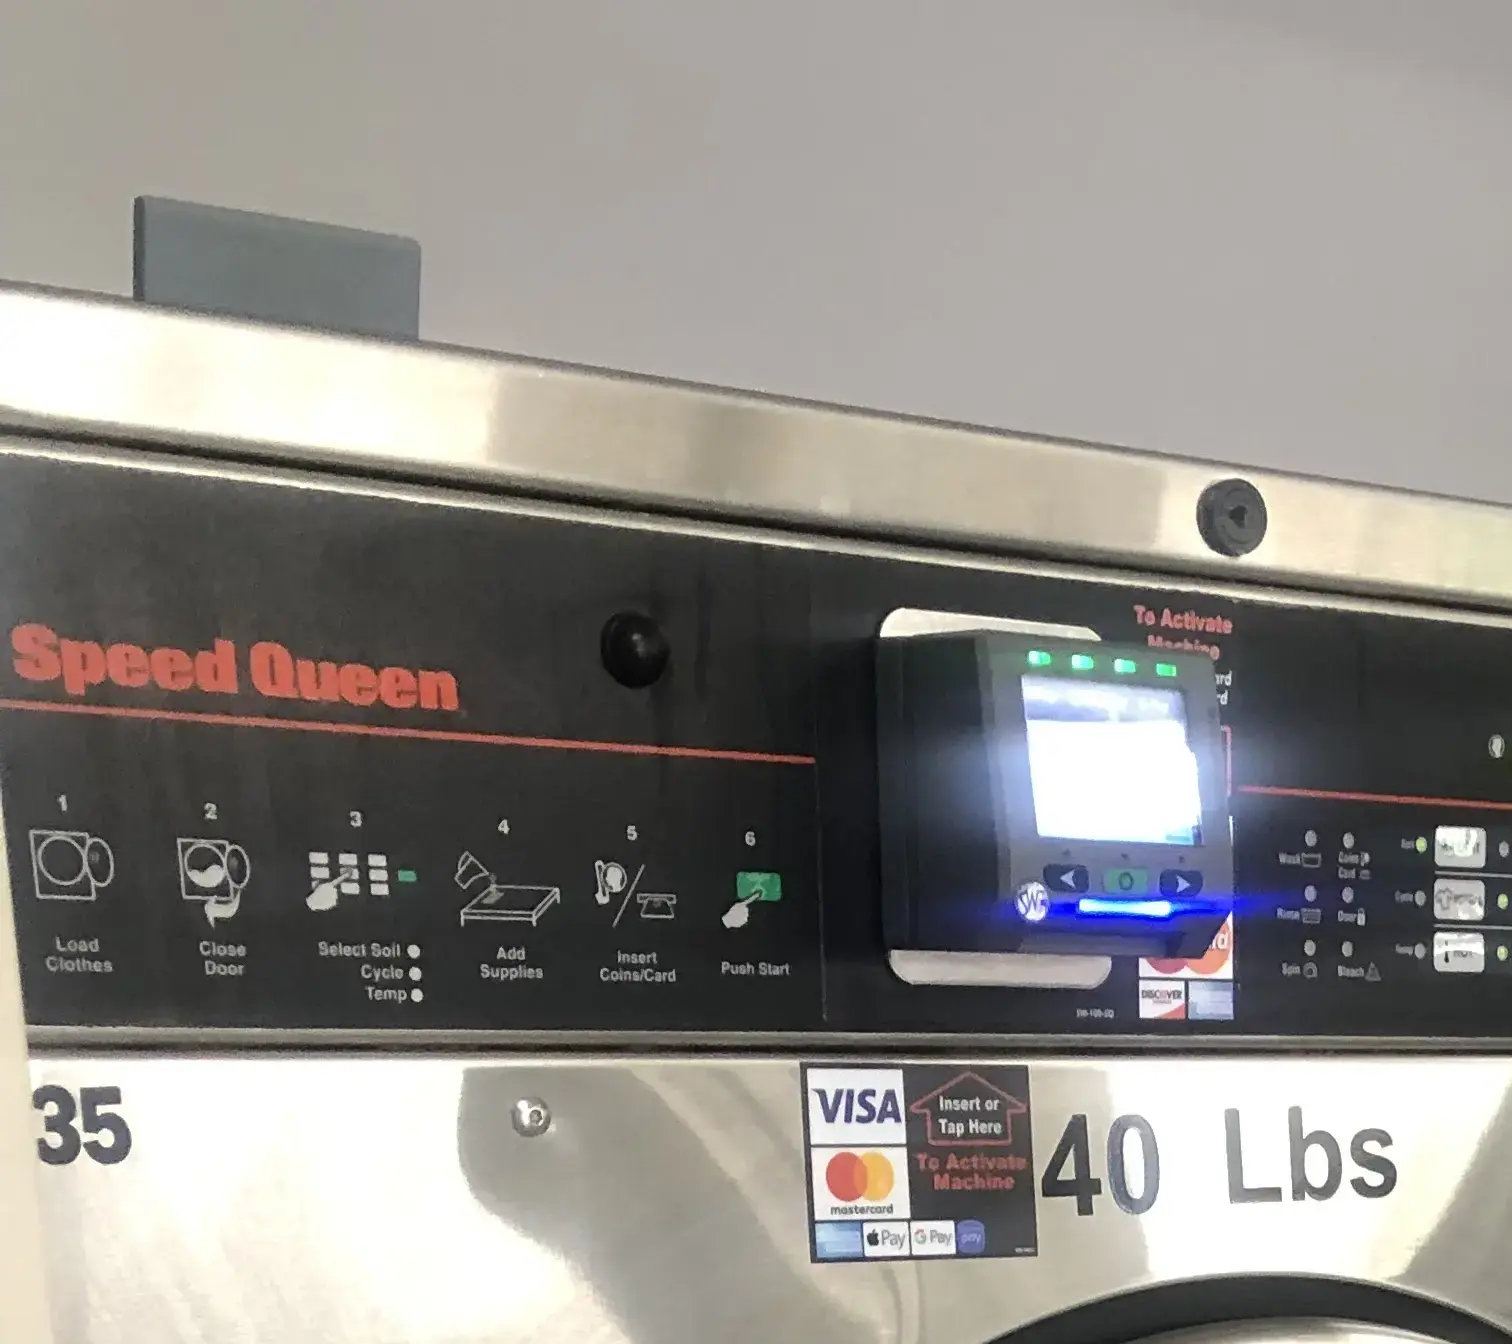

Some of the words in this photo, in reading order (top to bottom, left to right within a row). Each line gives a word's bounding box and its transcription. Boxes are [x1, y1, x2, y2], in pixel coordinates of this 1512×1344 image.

[1134, 604, 1156, 626] To
[1161, 608, 1233, 634] Activate
[12, 623, 238, 695] Speed
[250, 641, 459, 711] Queen
[58, 795, 67, 811] 1
[205, 803, 217, 819] 2
[350, 811, 361, 827] 3
[498, 819, 510, 834] 4
[626, 825, 637, 841] 5
[745, 831, 757, 846] 6
[56, 937, 99, 952] Load
[200, 941, 246, 957] Close
[318, 941, 366, 957] Select
[371, 941, 400, 957] Soil
[497, 947, 525, 961] Add
[617, 950, 658, 964] Insert
[46, 956, 113, 973] Clothes
[205, 961, 244, 977] Door
[480, 964, 543, 981] Supplies
[721, 962, 755, 976] Push
[759, 962, 790, 977] Start
[361, 964, 403, 982] Cycle
[600, 968, 676, 983] Coins/Card
[366, 986, 408, 1003] Temp
[811, 1088, 902, 1124] VISA
[939, 1096, 981, 1111] Insert
[984, 1097, 1000, 1111] or
[32, 1084, 132, 1165] 35
[939, 1119, 964, 1137] Tap
[968, 1119, 1002, 1134] Here
[916, 1152, 939, 1170] To
[946, 1153, 1029, 1170] Activate
[1041, 1114, 1160, 1216] 40
[1224, 1105, 1398, 1204] Lbs
[933, 1173, 1015, 1190] Machine
[830, 1204, 893, 1216] mastercard
[881, 1229, 906, 1250] Pay
[930, 1228, 953, 1248] Pay
